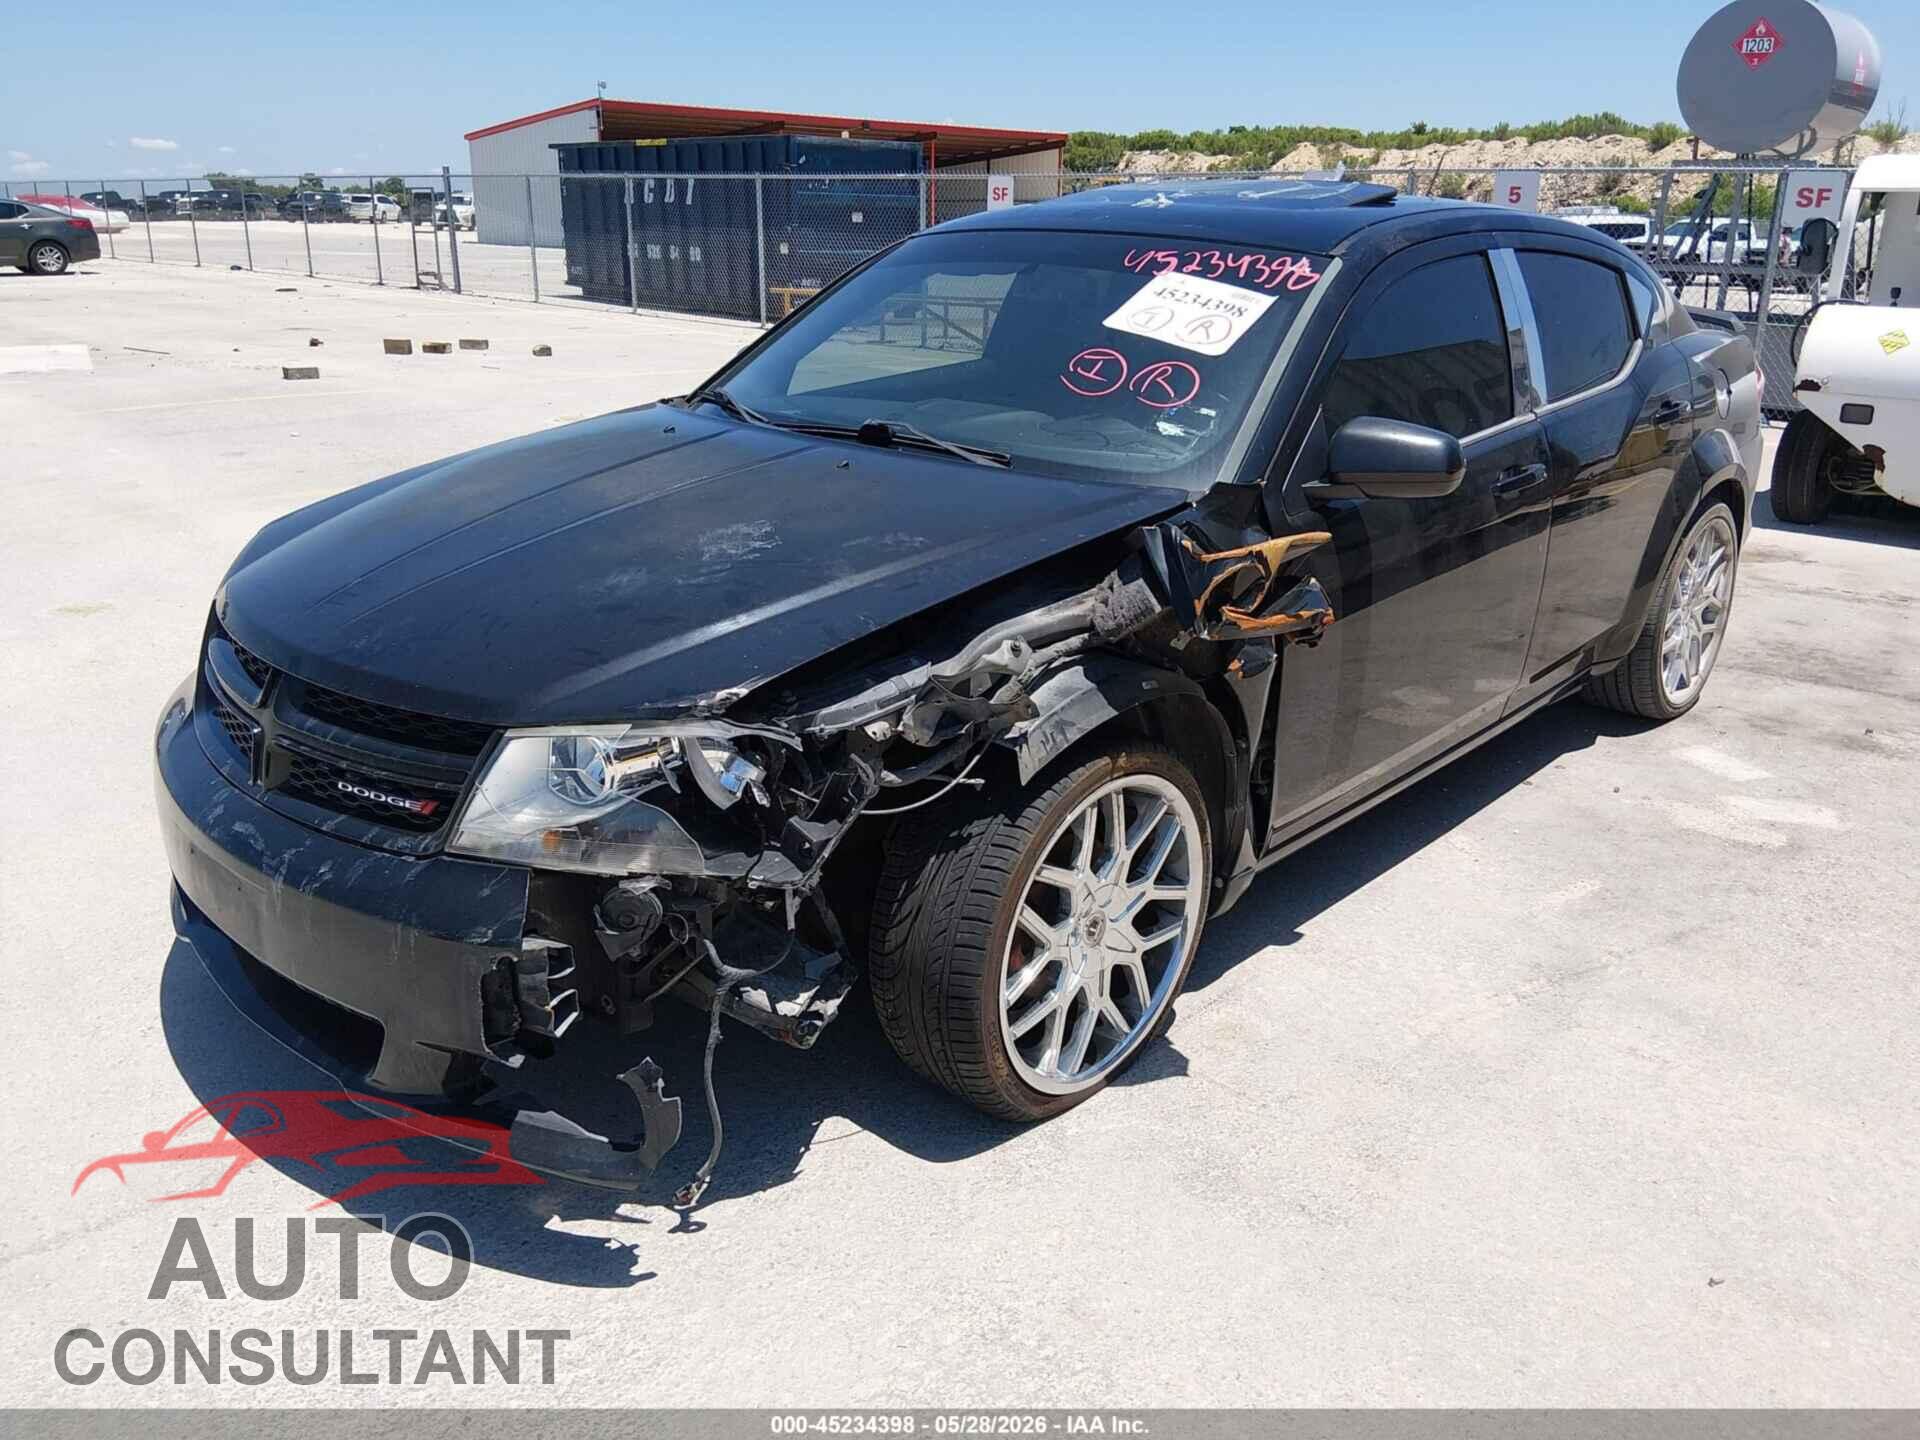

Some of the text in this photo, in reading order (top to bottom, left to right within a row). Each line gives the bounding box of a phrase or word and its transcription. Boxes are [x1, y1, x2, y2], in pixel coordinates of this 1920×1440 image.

[1745, 39, 1773, 52] 1203
[992, 187, 1009, 201] SF
[1508, 186, 1521, 204] 5
[1795, 187, 1833, 208] SF
[1154, 287, 1249, 318] 45234398
[337, 780, 424, 812] DODGE
